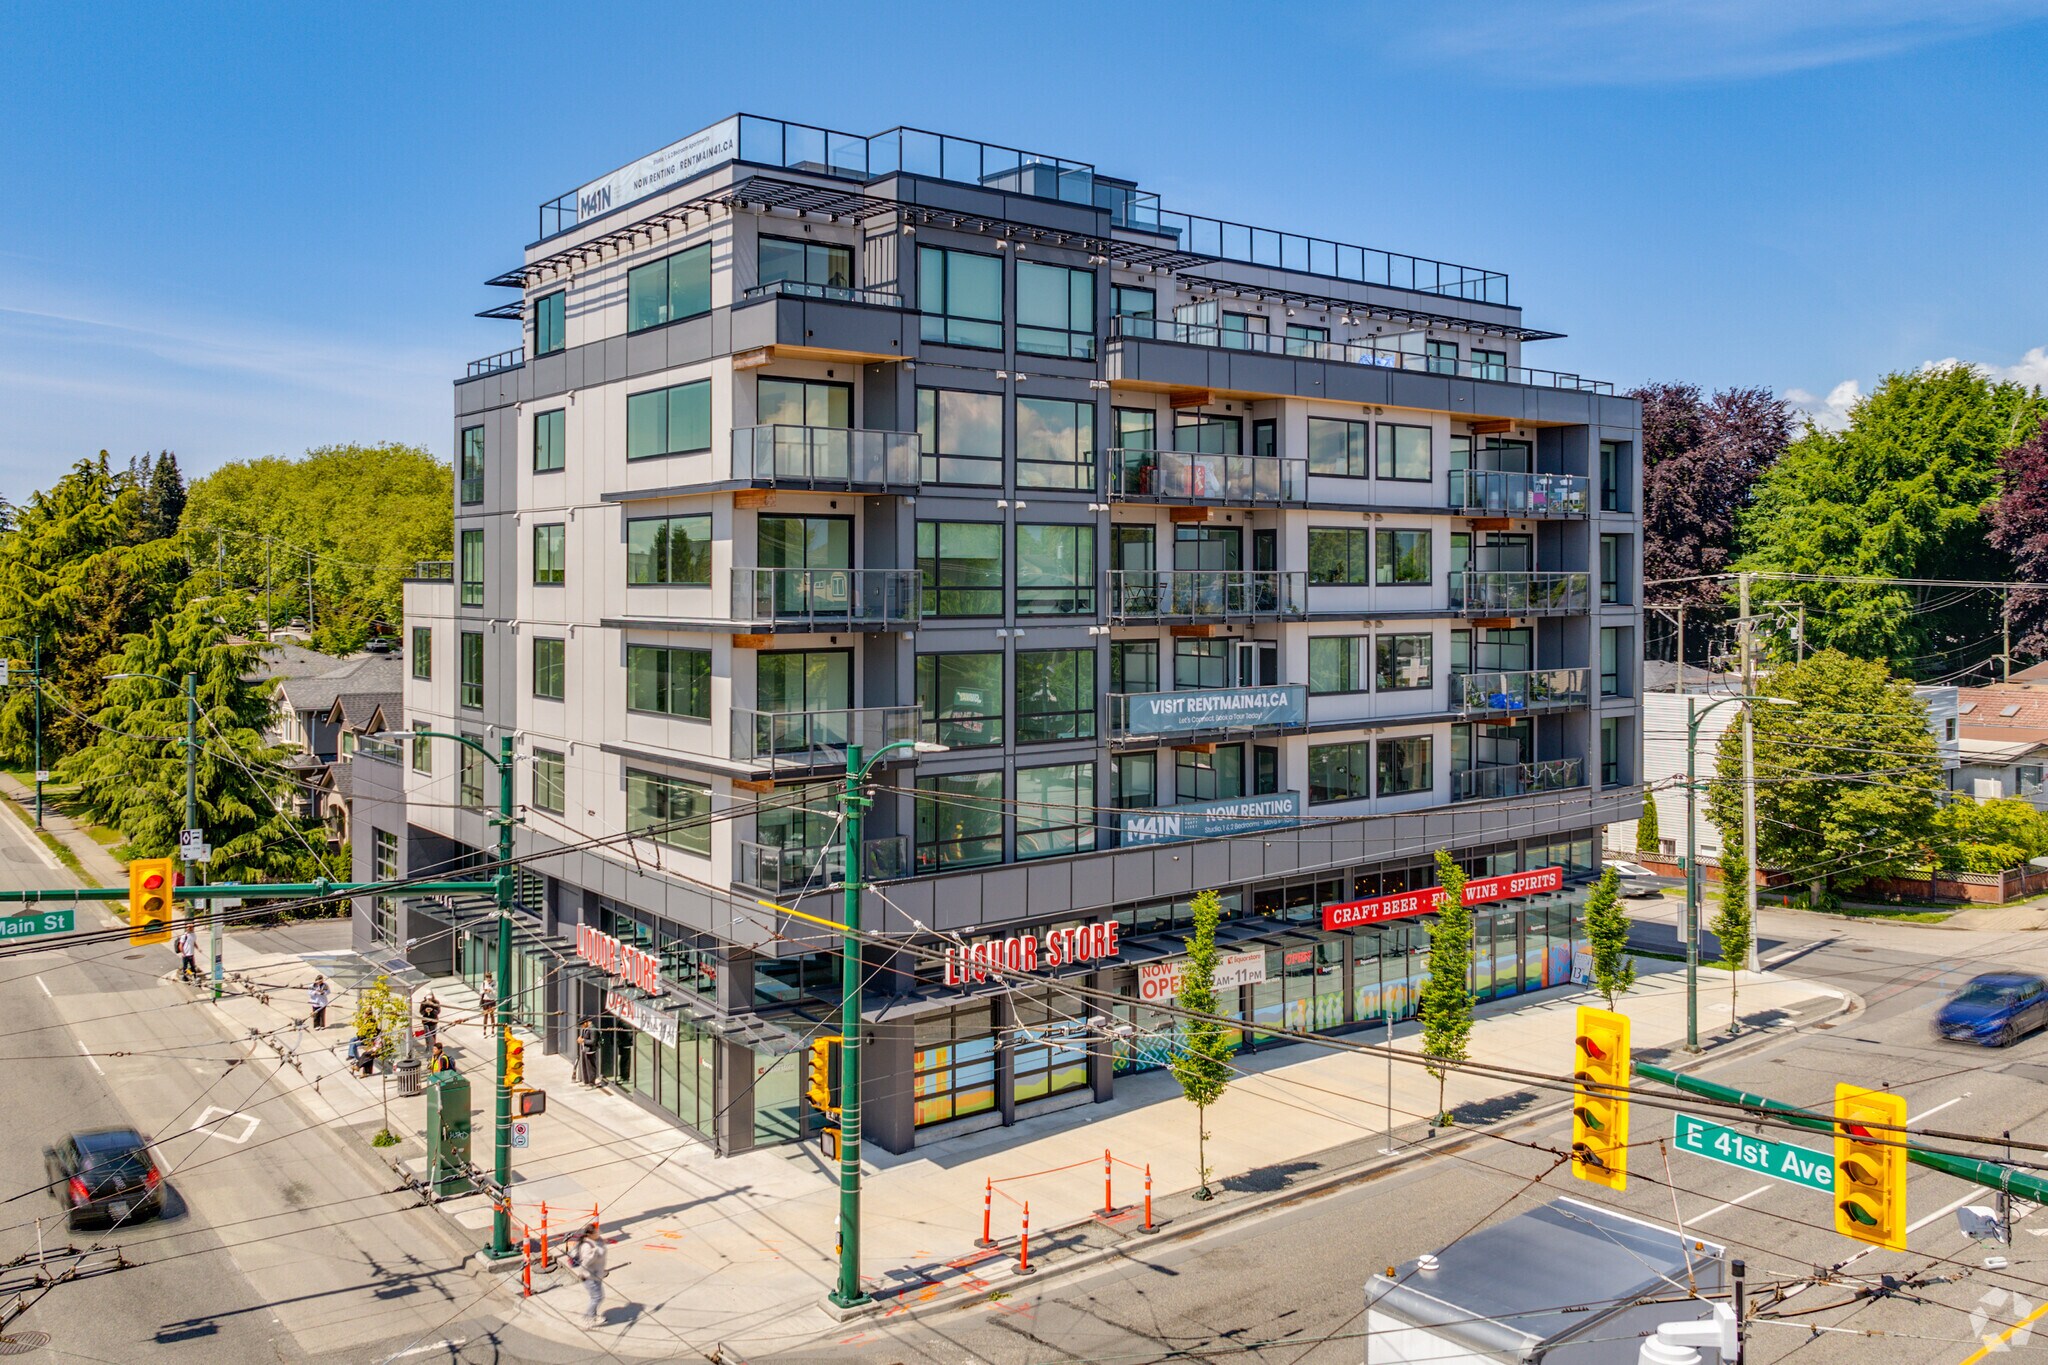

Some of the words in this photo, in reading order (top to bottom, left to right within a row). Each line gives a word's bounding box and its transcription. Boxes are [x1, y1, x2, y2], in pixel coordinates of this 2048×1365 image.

[633, 175, 648, 190] NOW
[650, 164, 676, 183] RENTING
[680, 139, 733, 171] RENTMAIN41.CA
[1151, 698, 1185, 715] VISIT
[1187, 692, 1288, 713] RENTMAIN41.CA
[1178, 716, 1190, 724] Let's
[1246, 712, 1263, 720] Today!
[1206, 804, 1239, 822] NOW
[1241, 798, 1292, 817] RENTING
[1128, 814, 1180, 842] M41N
[1234, 820, 1260, 830] Bedrooms
[1332, 903, 1379, 924] CRAFT
[1382, 897, 1418, 916] BEER
[1466, 883, 1498, 901] WINE
[1510, 873, 1556, 893] SPIRITS
[44, 915, 65, 930] St
[576, 922, 622, 974] LIQUOR
[620, 944, 662, 996] STORE
[944, 935, 1038, 986] LIQUOR
[1045, 920, 1120, 967] STORE
[1141, 962, 1173, 979] NOW
[608, 991, 634, 1020] OPEN
[1687, 1122, 1703, 1149] E
[1714, 1132, 1769, 1168] 41st
[1780, 1150, 1832, 1185] Ave
